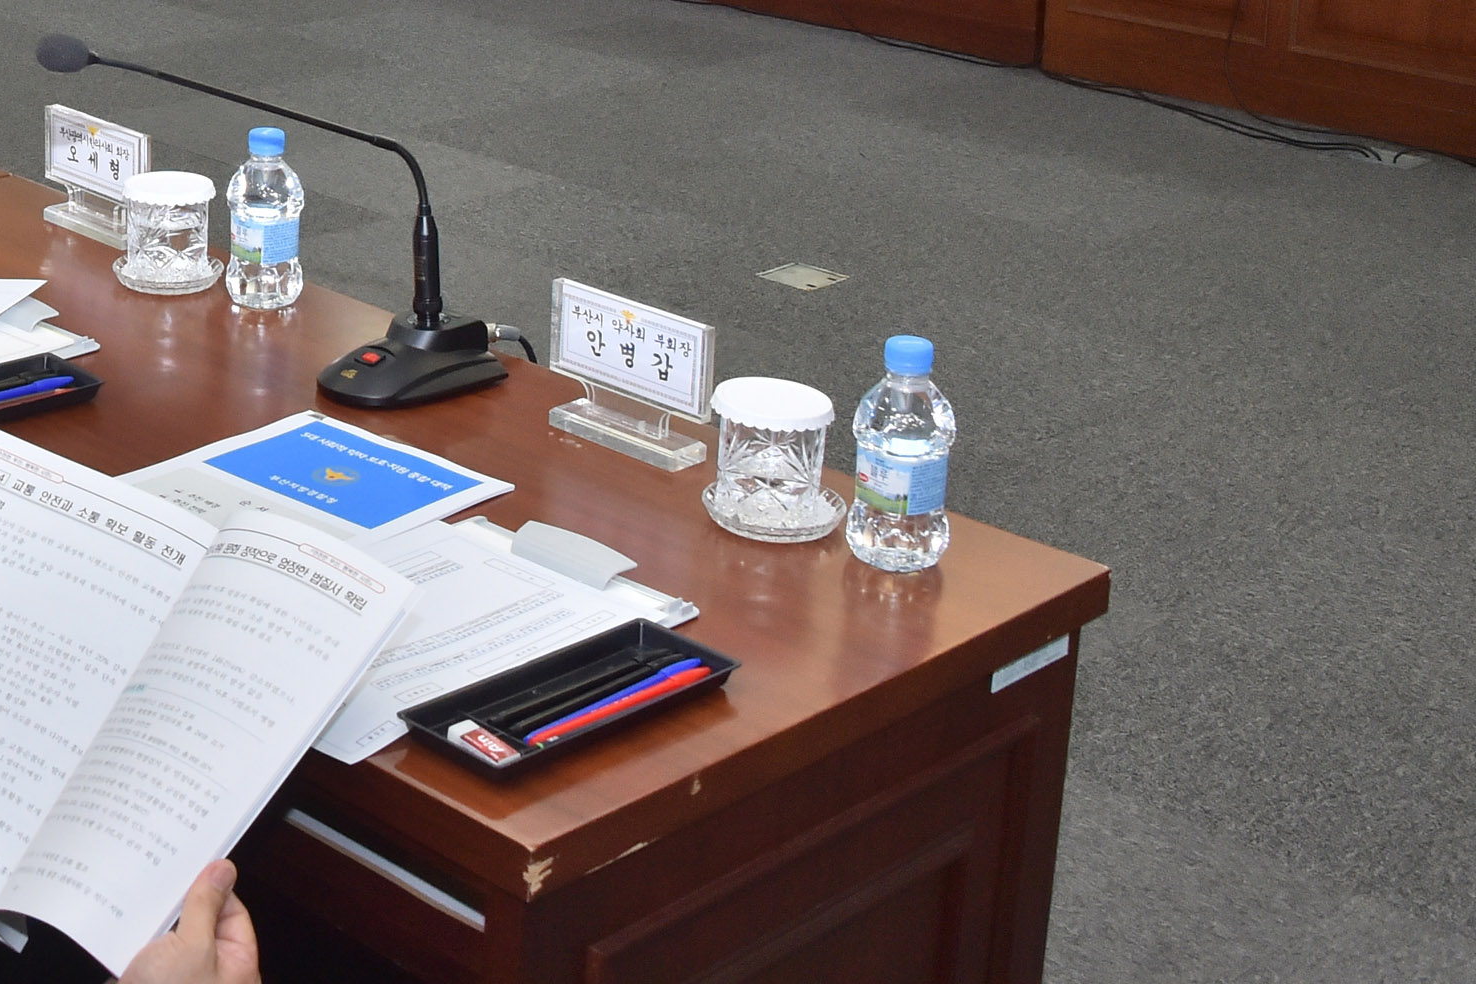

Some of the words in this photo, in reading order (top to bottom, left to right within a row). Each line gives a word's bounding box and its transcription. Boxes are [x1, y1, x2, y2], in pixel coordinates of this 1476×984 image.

[572, 306, 604, 327] 부산시
[612, 319, 646, 342] 약사회
[654, 334, 692, 358] 부회장
[587, 330, 606, 357] 안
[620, 342, 635, 368] 병
[651, 352, 673, 381] 갑
[269, 474, 338, 504] 부산지방경찰청
[10, 477, 37, 497] 교통
[37, 488, 75, 514] 안전과
[74, 504, 101, 525] 소통
[102, 516, 129, 537] 확보
[130, 529, 158, 551] 활동
[158, 543, 188, 566] 전개
[240, 546, 277, 564] 정착으로
[277, 557, 310, 578] 엄정한
[309, 571, 344, 596] 법질서
[344, 590, 368, 611] 확립
[477, 735, 505, 752] Ain
